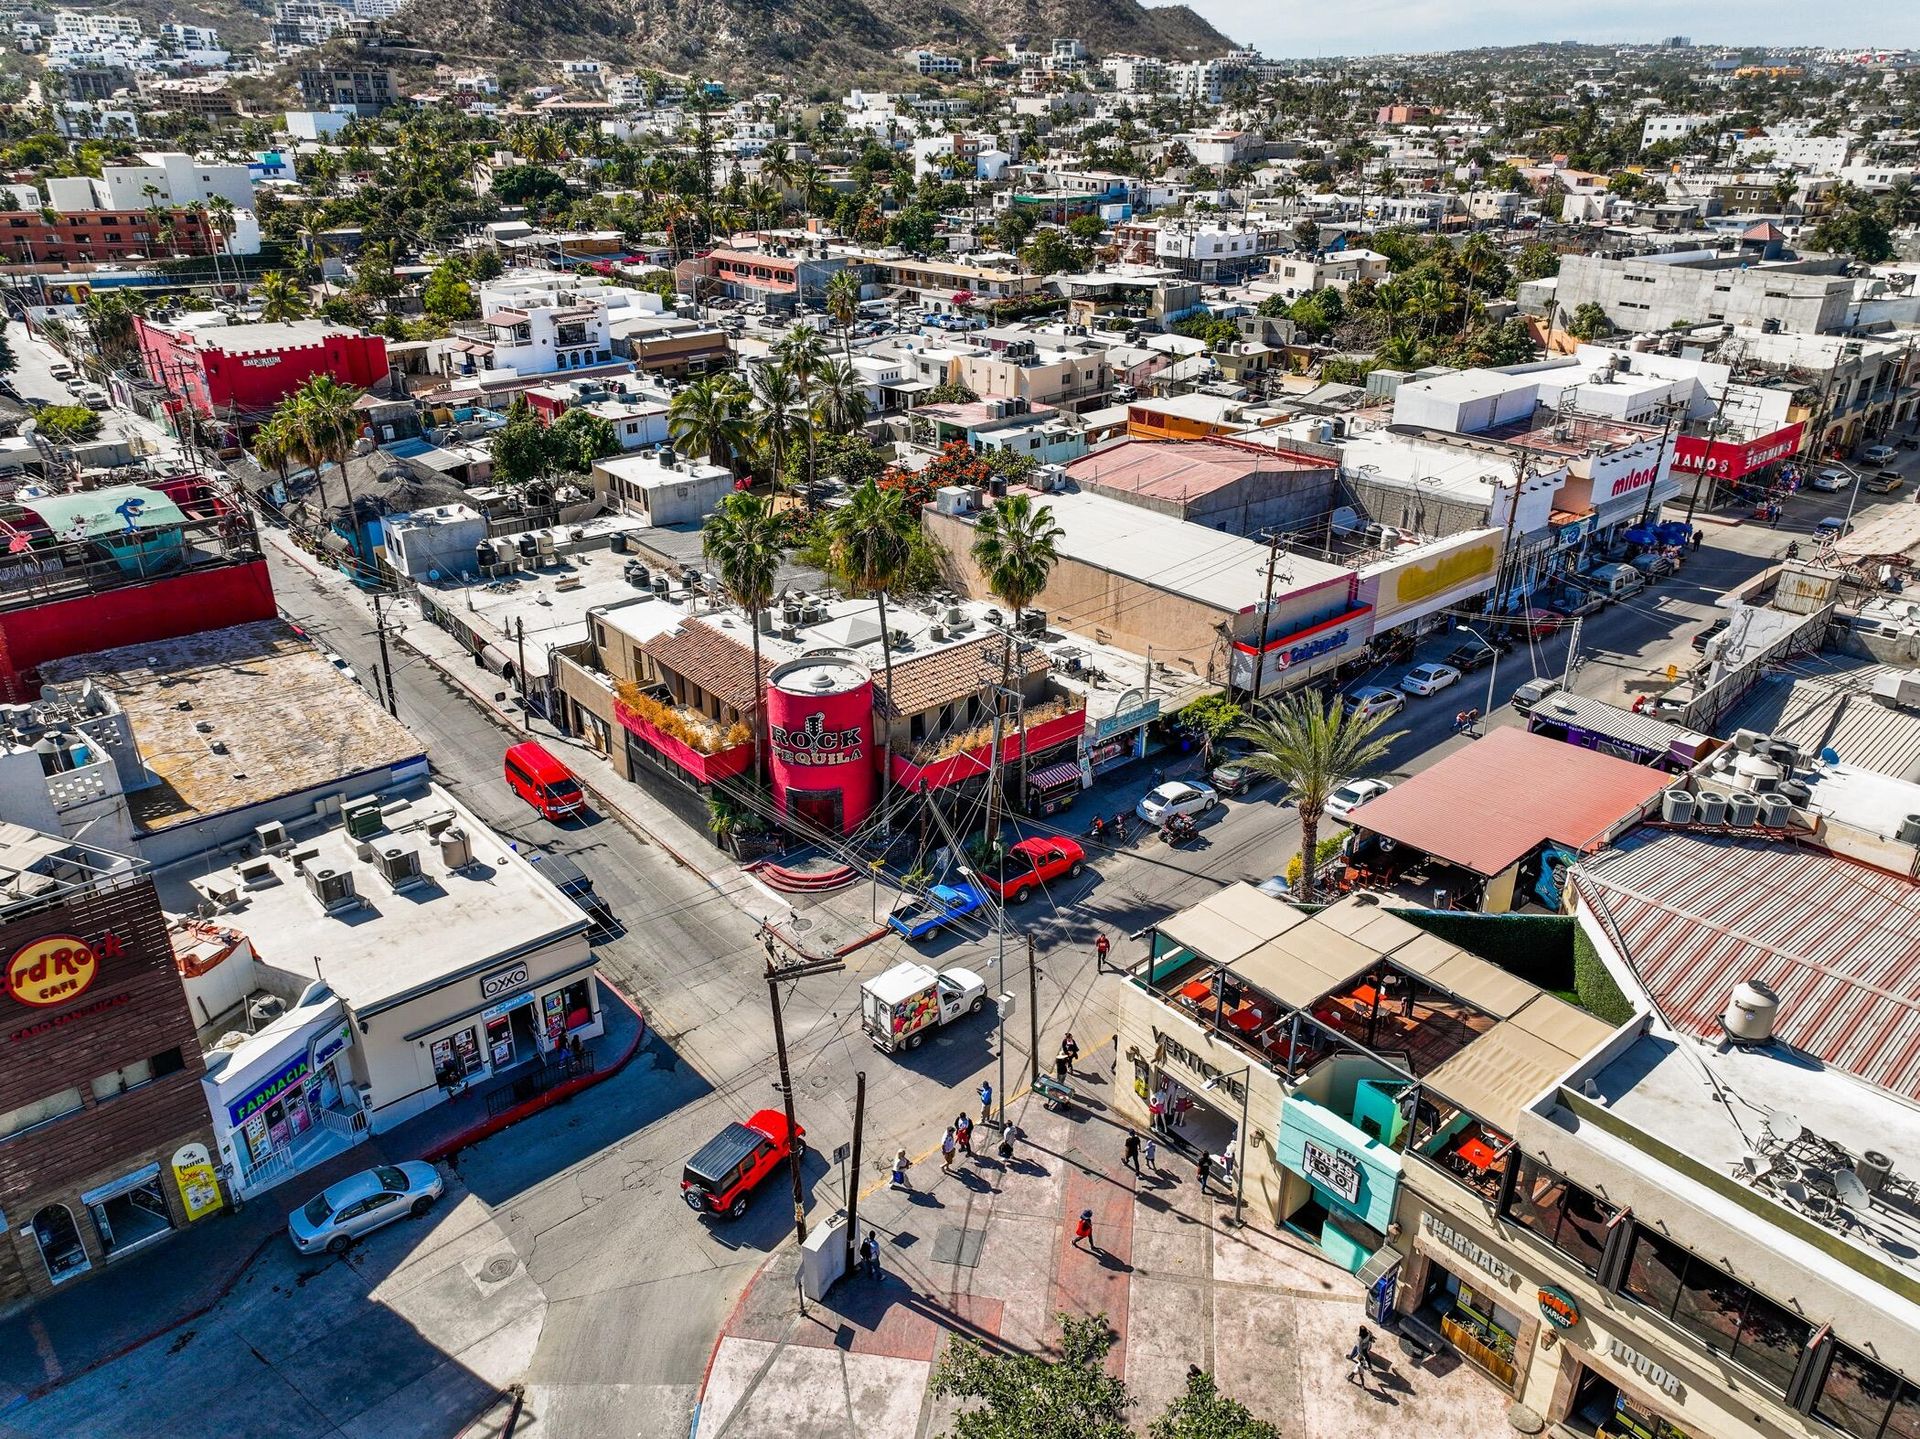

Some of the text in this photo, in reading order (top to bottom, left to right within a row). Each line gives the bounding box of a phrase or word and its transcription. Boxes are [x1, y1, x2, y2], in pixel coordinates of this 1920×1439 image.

[770, 723, 863, 750] ROCK
[772, 745, 863, 765] TEQUILA
[39, 978, 79, 999] CAFE
[486, 969, 527, 994] OXXO
[237, 1062, 309, 1121] FARMACIA
[1311, 1147, 1355, 1181] TAPES
[1422, 1210, 1517, 1284] PHARMACY
[1541, 1303, 1572, 1327] MARKET
